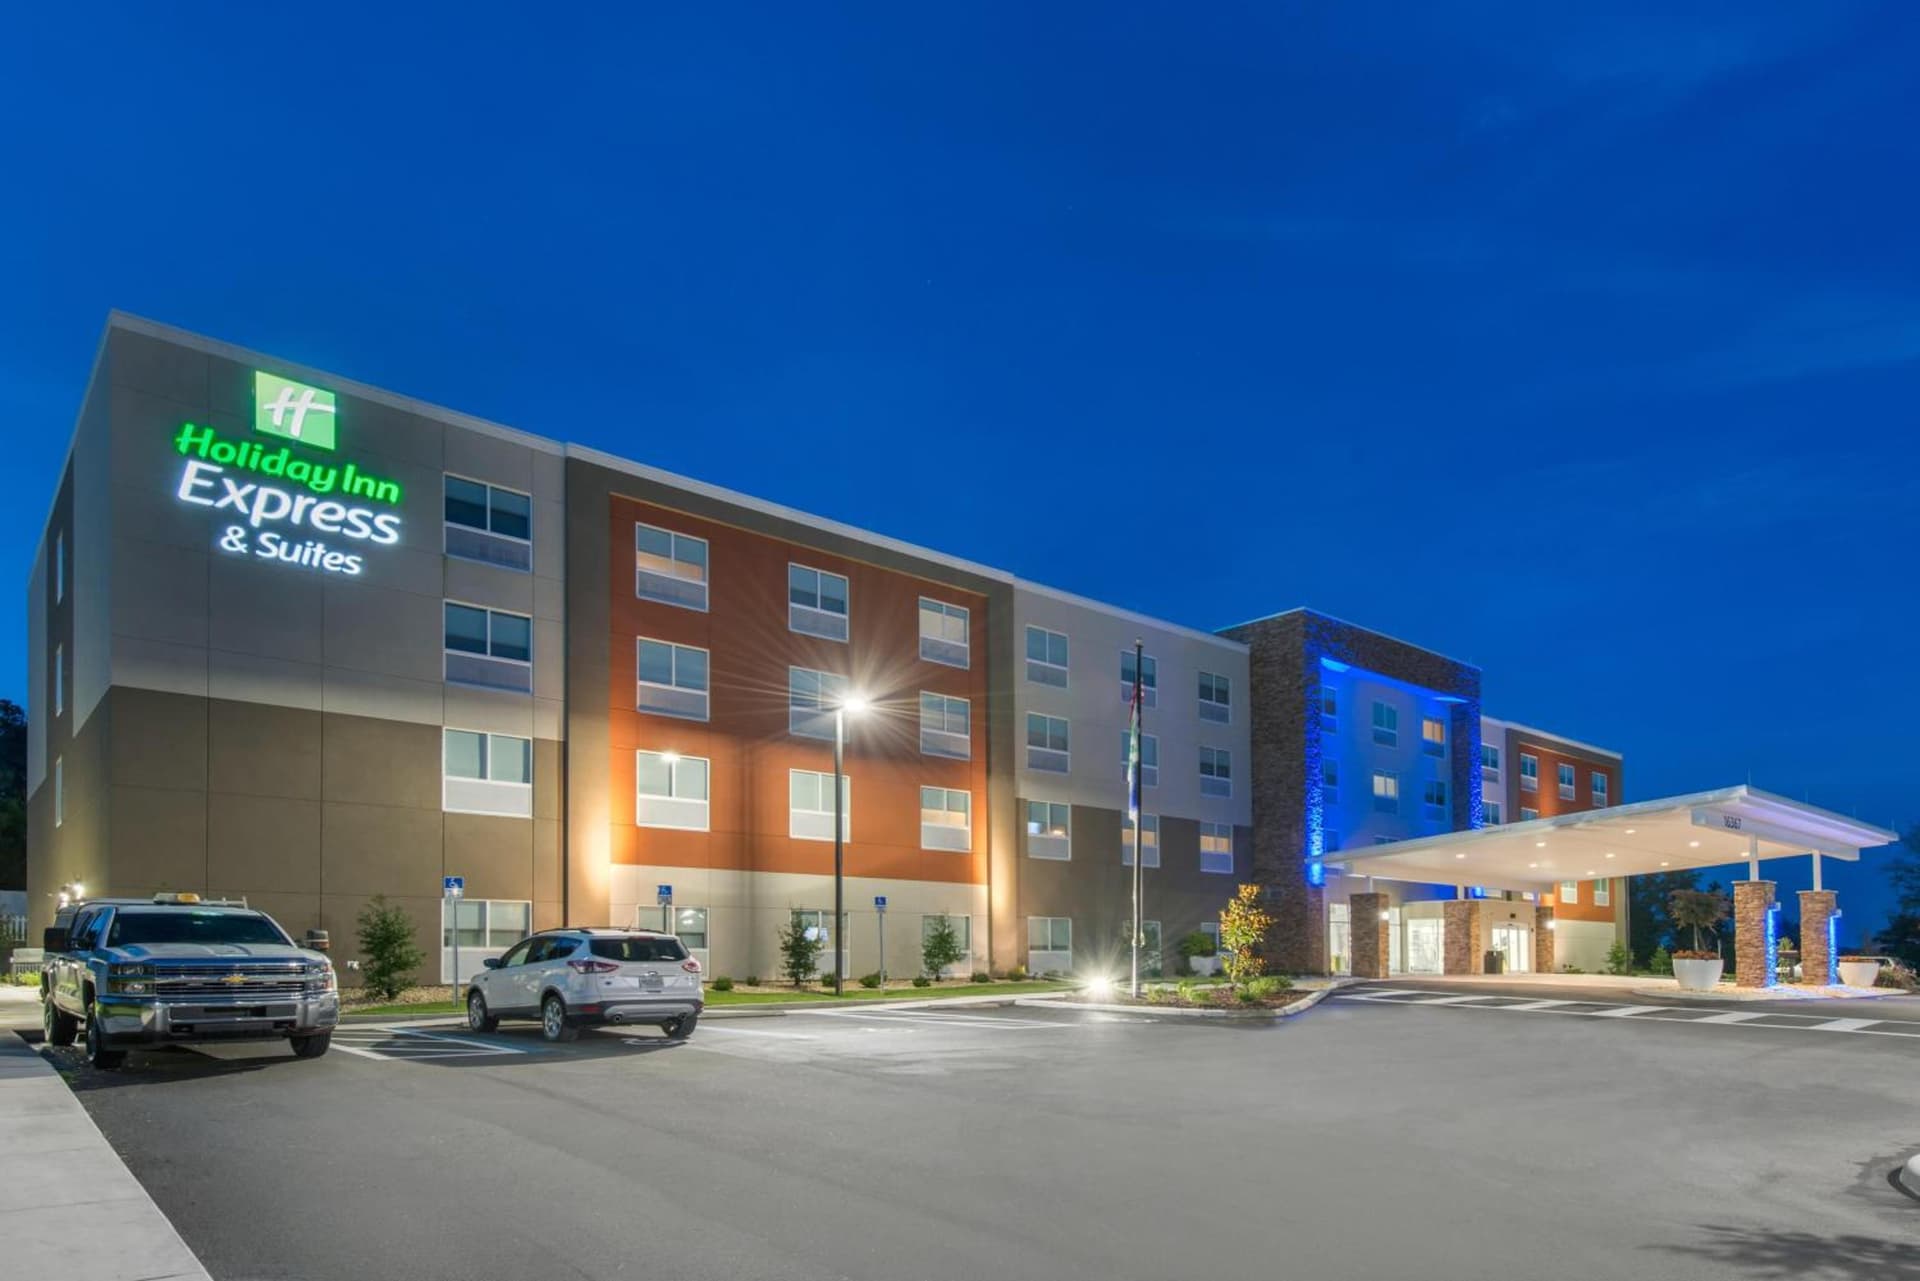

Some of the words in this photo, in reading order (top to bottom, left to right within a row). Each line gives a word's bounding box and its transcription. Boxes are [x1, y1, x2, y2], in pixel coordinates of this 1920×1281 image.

[176, 423, 337, 492] Holiday
[342, 464, 400, 503] Inn
[178, 460, 401, 544] Express
[220, 526, 248, 553] &
[255, 532, 362, 575] Suites
